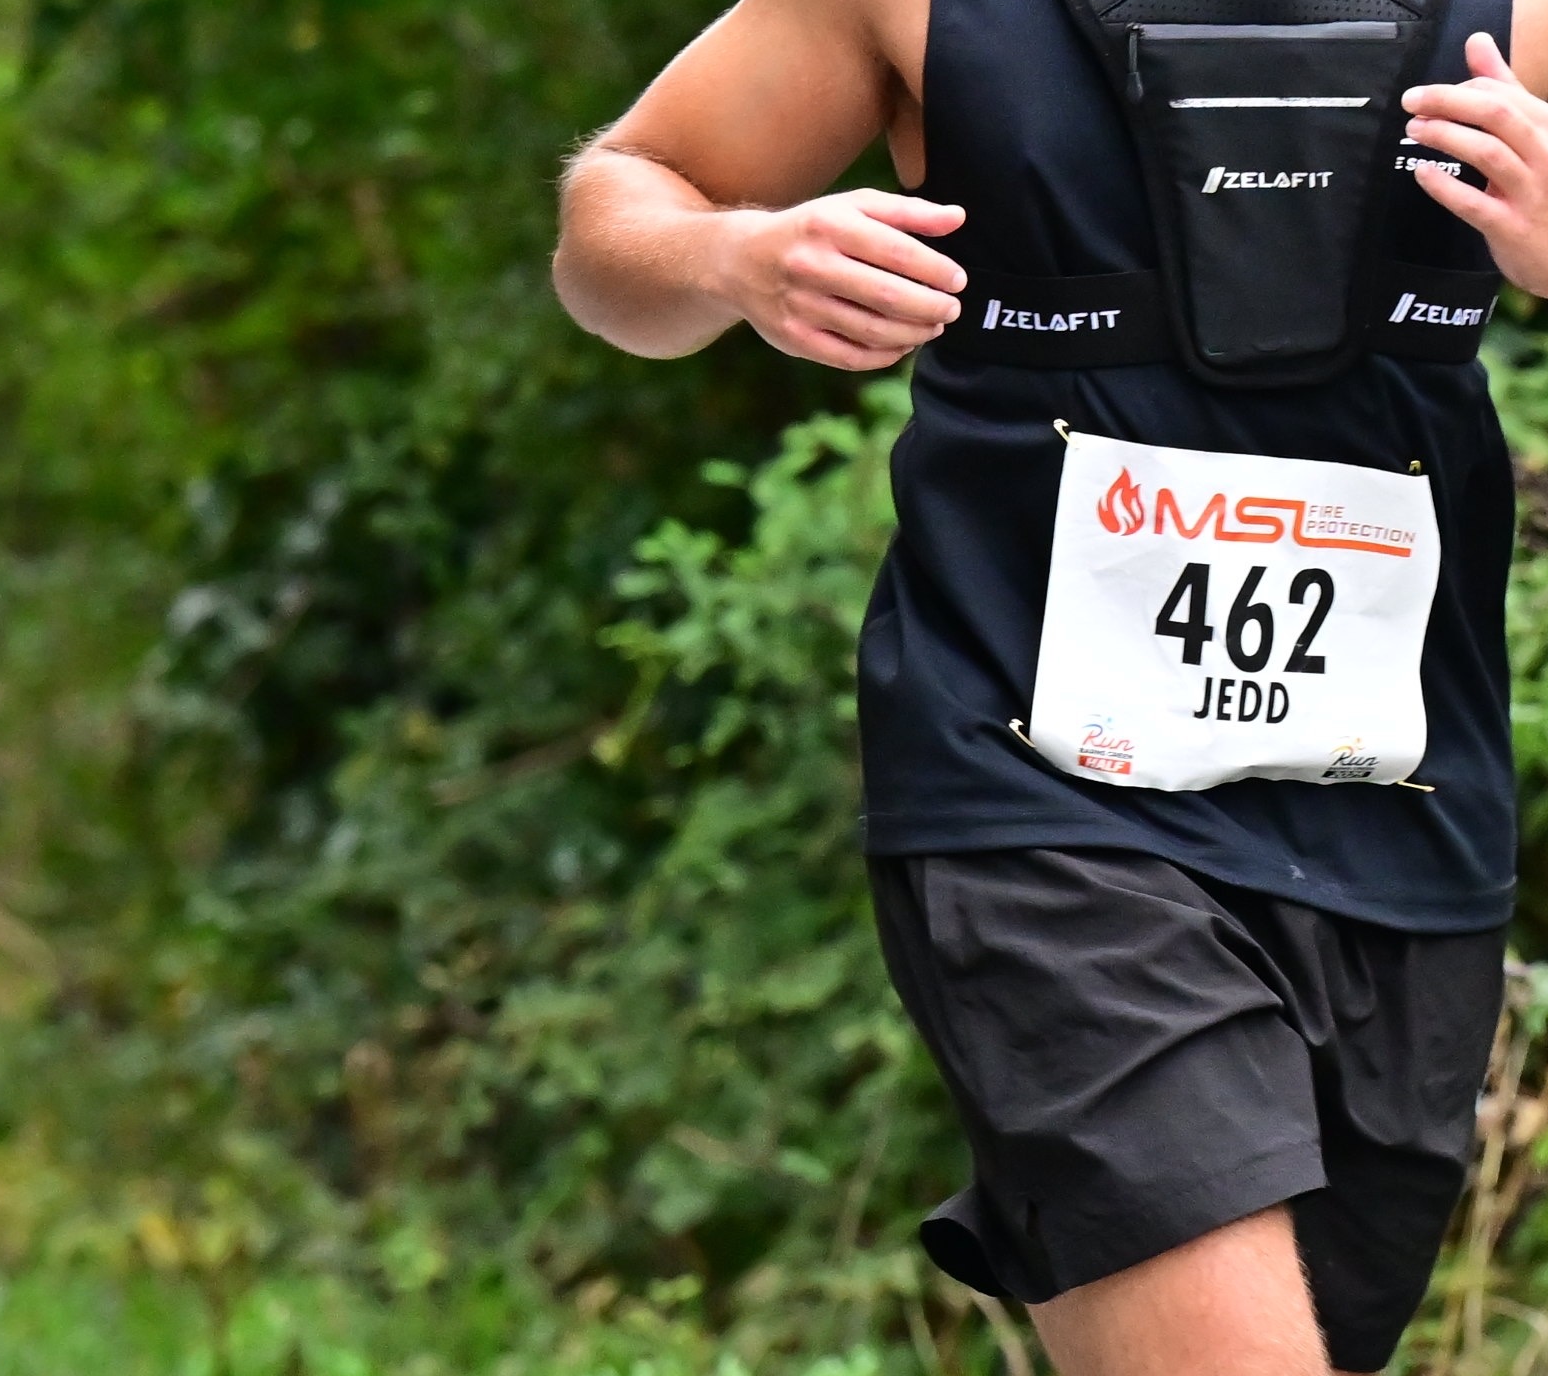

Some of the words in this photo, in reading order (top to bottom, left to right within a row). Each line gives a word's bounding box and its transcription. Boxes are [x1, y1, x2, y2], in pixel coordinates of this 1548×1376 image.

[1222, 171, 1334, 189] ZELAFIT
[1001, 308, 1121, 332] ZELAFIT
[1309, 504, 1344, 520] FIRE
[1306, 520, 1416, 543] PROTECTION
[1154, 562, 1335, 674] 462
[1193, 677, 1290, 724] JEDD
[1085, 757, 1126, 772] HALF
